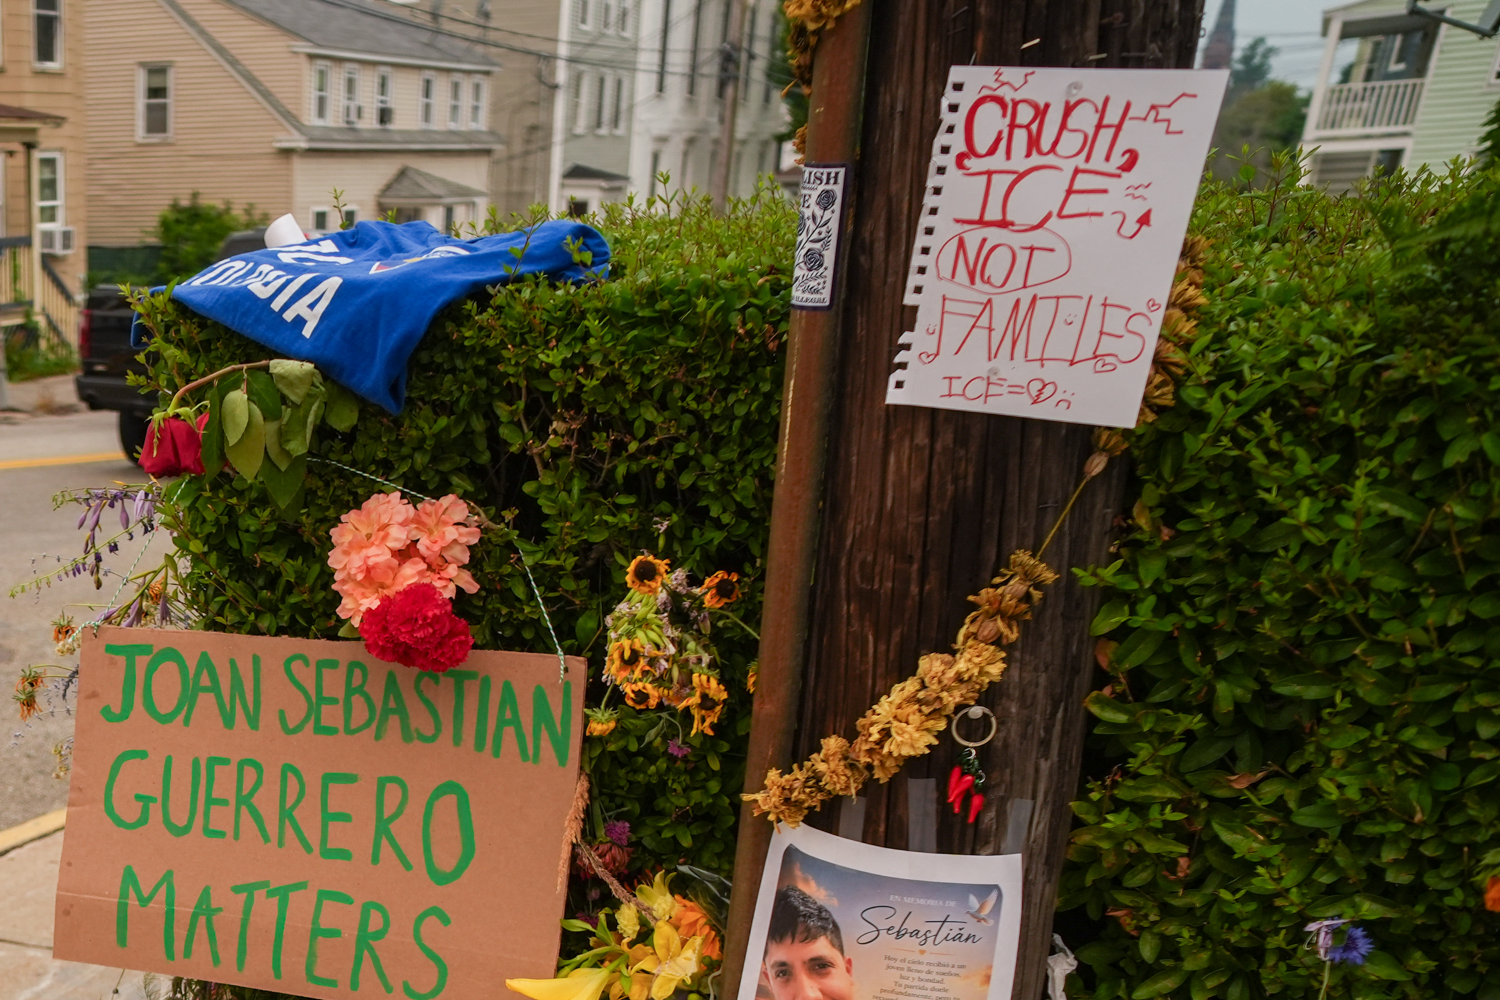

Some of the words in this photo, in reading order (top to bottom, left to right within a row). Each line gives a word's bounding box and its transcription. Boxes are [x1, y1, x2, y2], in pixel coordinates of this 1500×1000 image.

[964, 95, 1131, 163] CRUSH
[953, 164, 1122, 232] ICE
[952, 235, 1055, 289] NOT
[935, 294, 1152, 368] FAMILIES
[99, 643, 261, 732] JOAN
[278, 653, 572, 768] SEBASTIAN
[104, 749, 476, 887] GUERRERO
